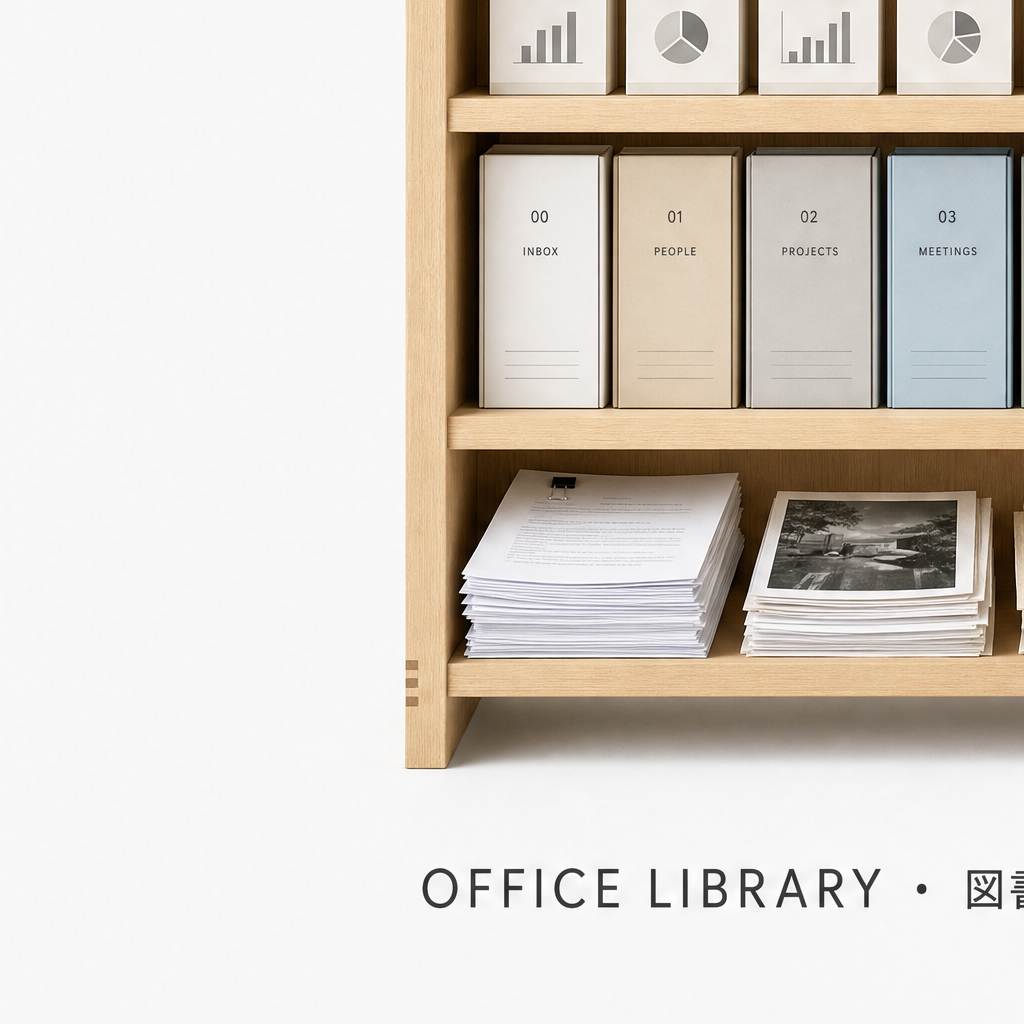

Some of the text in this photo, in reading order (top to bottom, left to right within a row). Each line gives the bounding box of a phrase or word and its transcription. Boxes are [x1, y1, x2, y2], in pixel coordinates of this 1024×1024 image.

[530, 210, 549, 224] 00
[667, 210, 682, 224] 01
[800, 209, 818, 224] 02
[938, 209, 957, 224] 03
[523, 246, 559, 257] INBOX
[654, 246, 697, 257] PEOPLE
[781, 246, 839, 257] PROJECTS
[918, 246, 978, 257] MEETINGS
